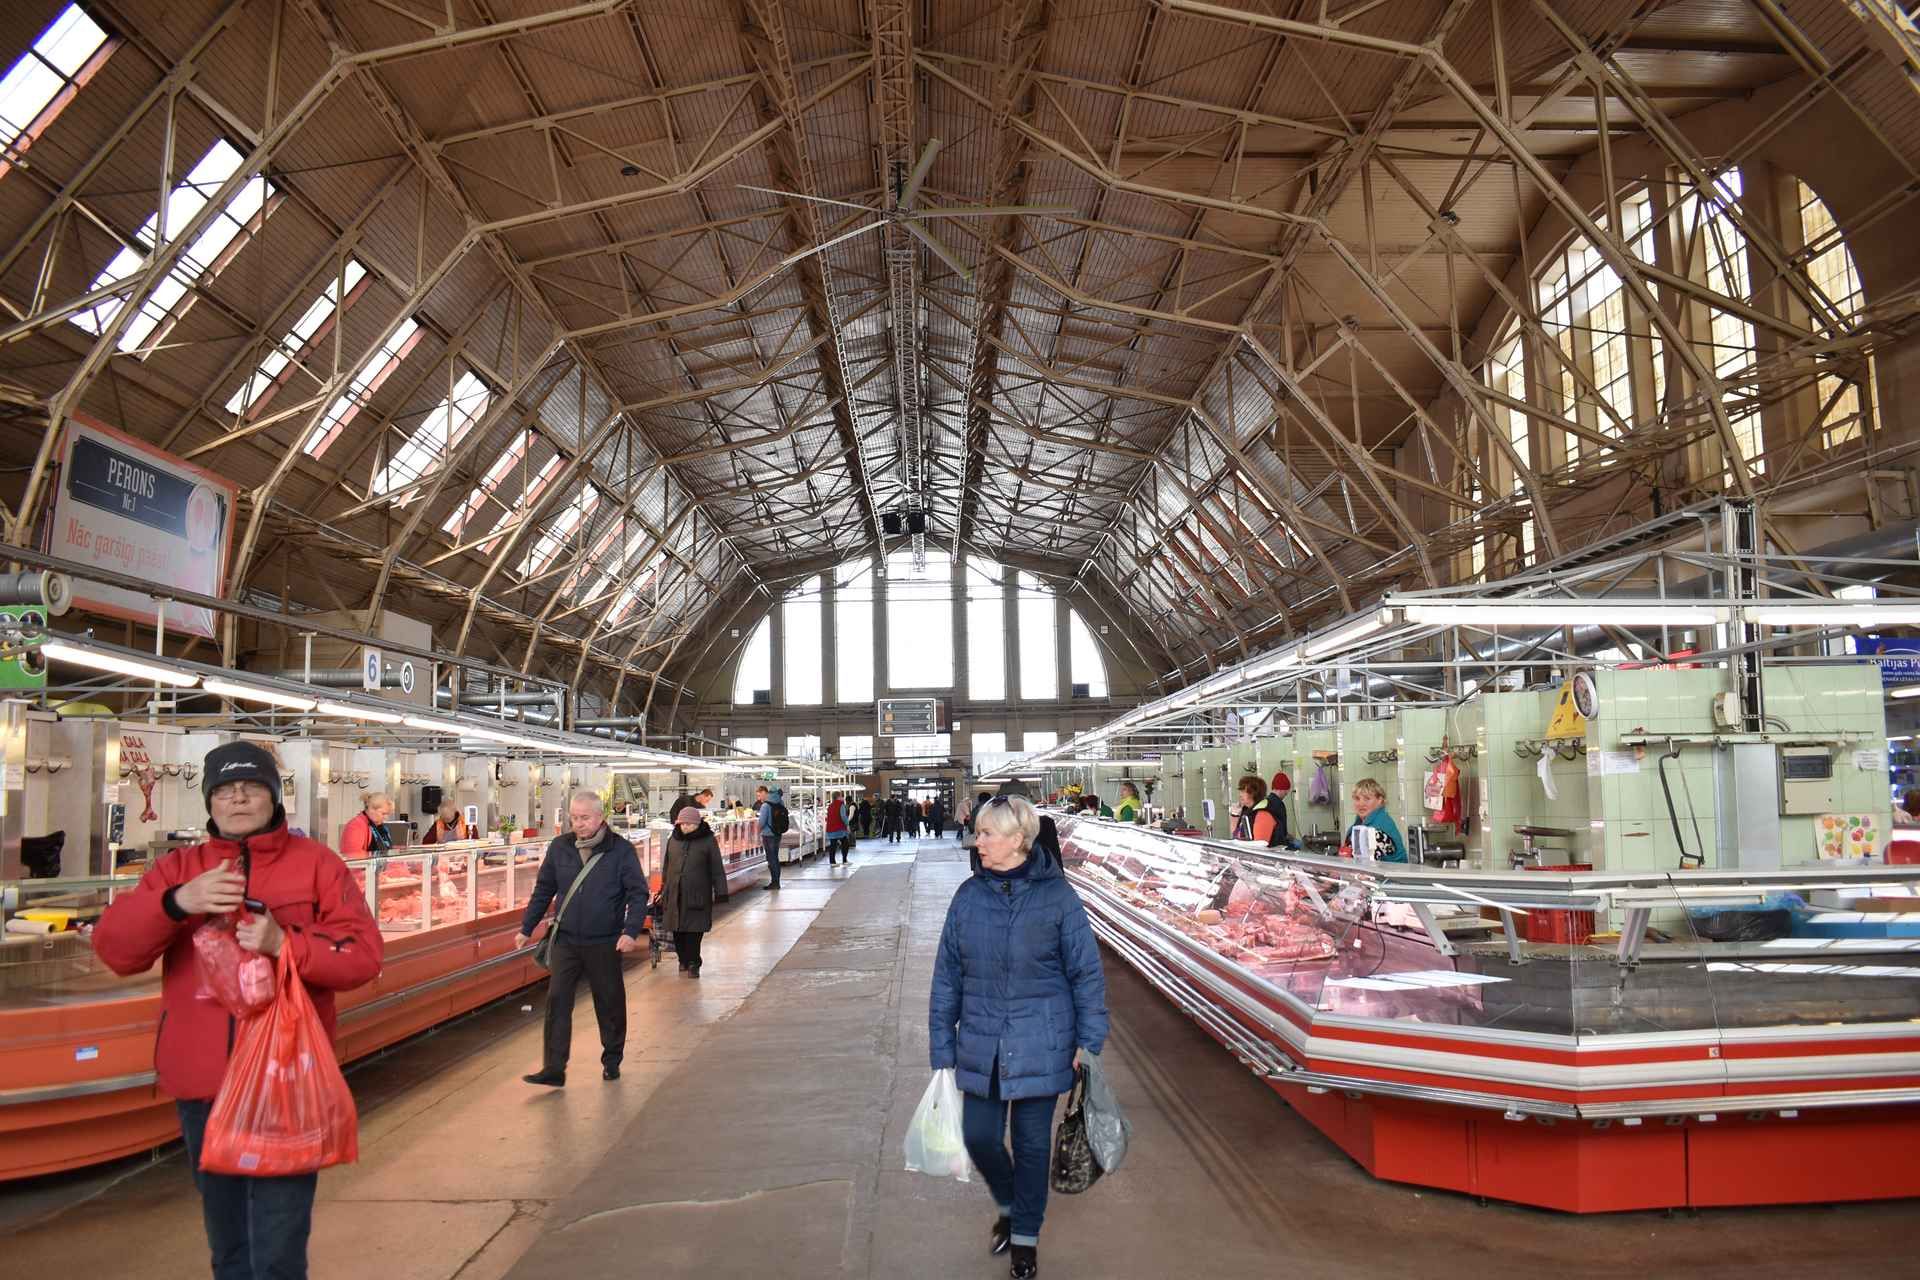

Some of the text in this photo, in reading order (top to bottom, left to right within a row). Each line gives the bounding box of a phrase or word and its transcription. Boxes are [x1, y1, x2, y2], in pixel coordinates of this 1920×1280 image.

[107, 457, 155, 498] PERONS
[122, 492, 137, 512] Nr.1
[368, 654, 378, 682] 6
